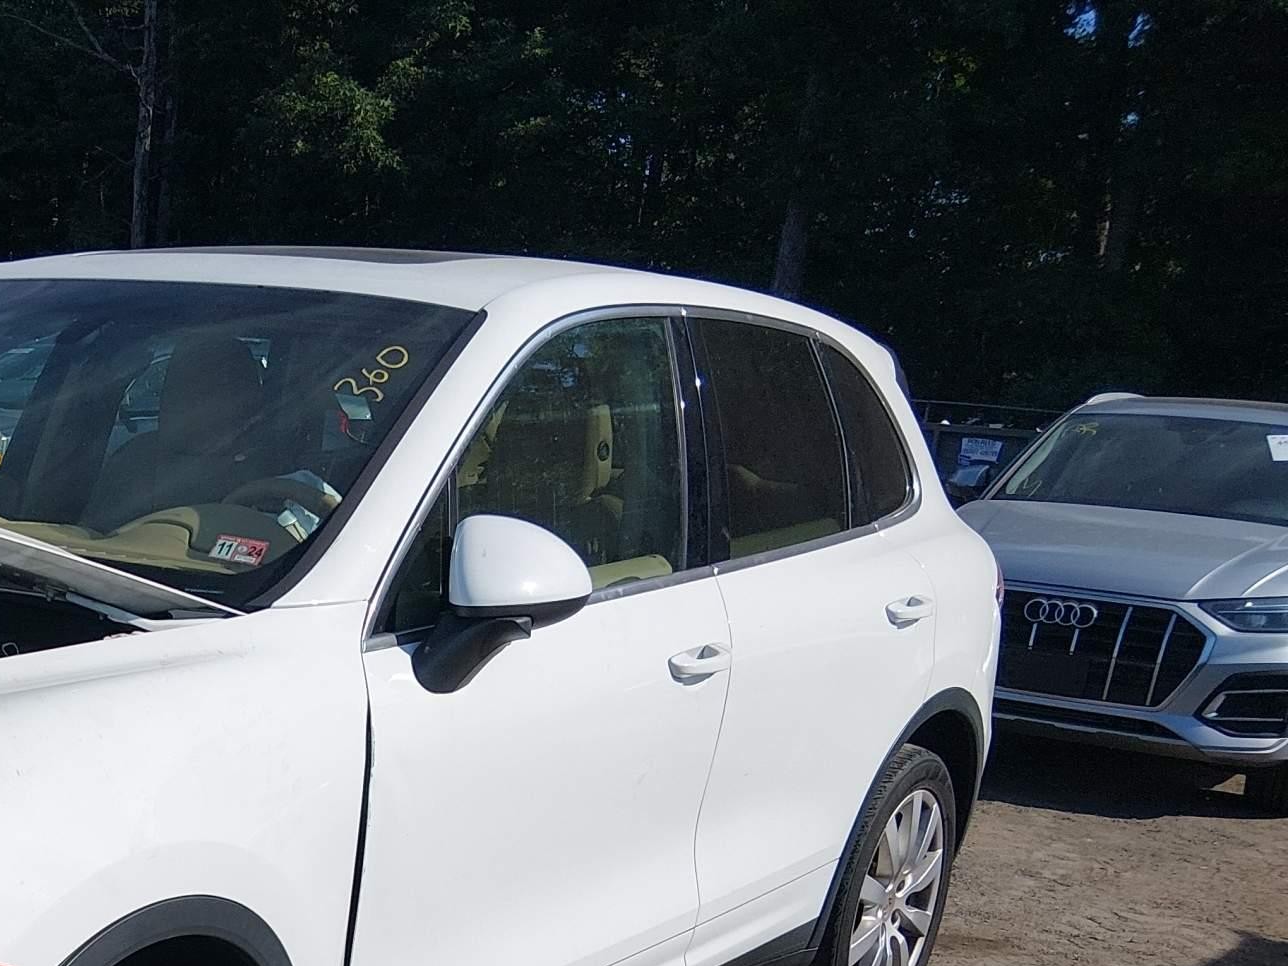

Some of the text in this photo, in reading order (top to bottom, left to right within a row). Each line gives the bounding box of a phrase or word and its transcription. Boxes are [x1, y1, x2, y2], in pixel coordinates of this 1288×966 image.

[333, 345, 409, 402] 360
[217, 541, 264, 558] 11 24
